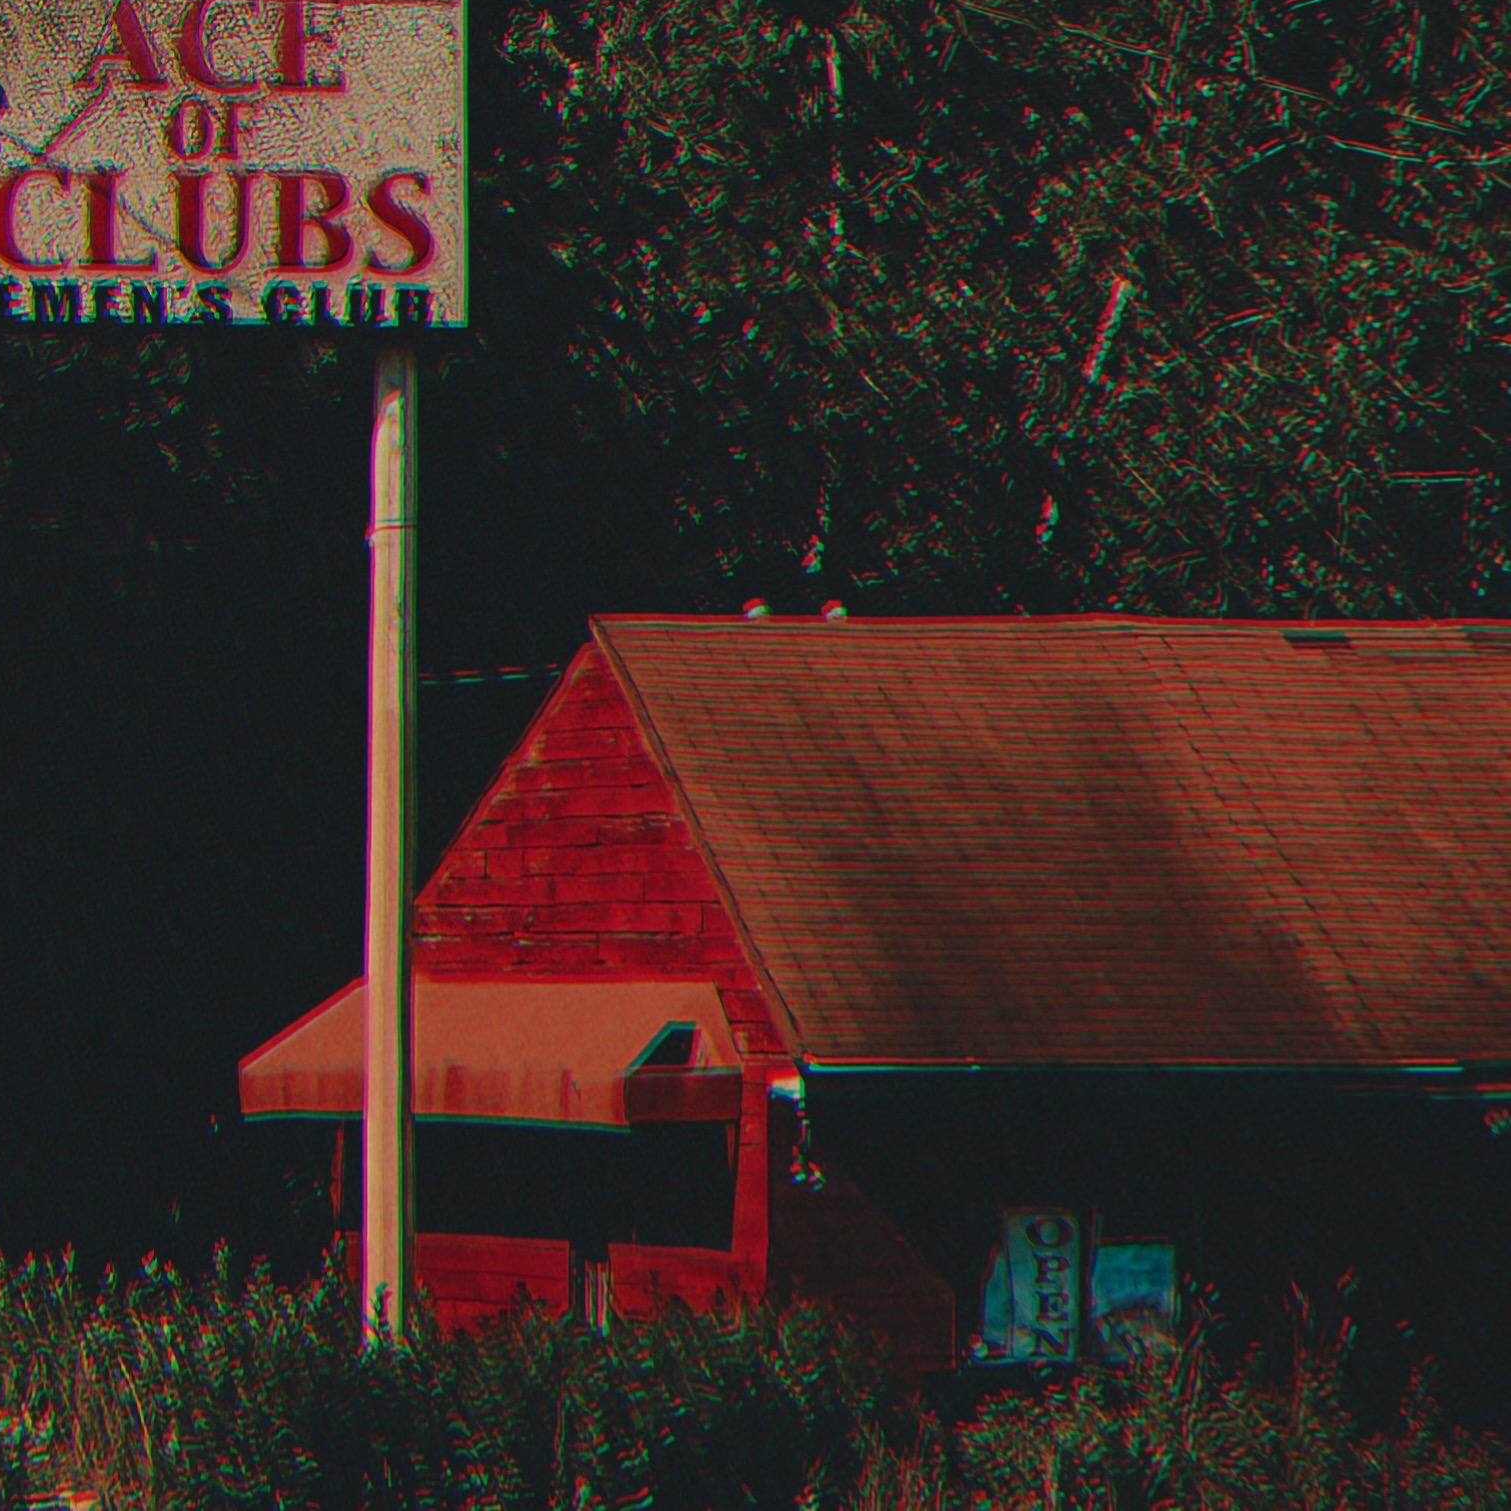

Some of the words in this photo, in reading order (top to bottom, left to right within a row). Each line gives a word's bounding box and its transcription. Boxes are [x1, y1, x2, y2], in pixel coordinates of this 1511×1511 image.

[167, 96, 257, 160] OF
[263, 280, 433, 327] CLUB
[1025, 1216, 1073, 1361] OPEN
